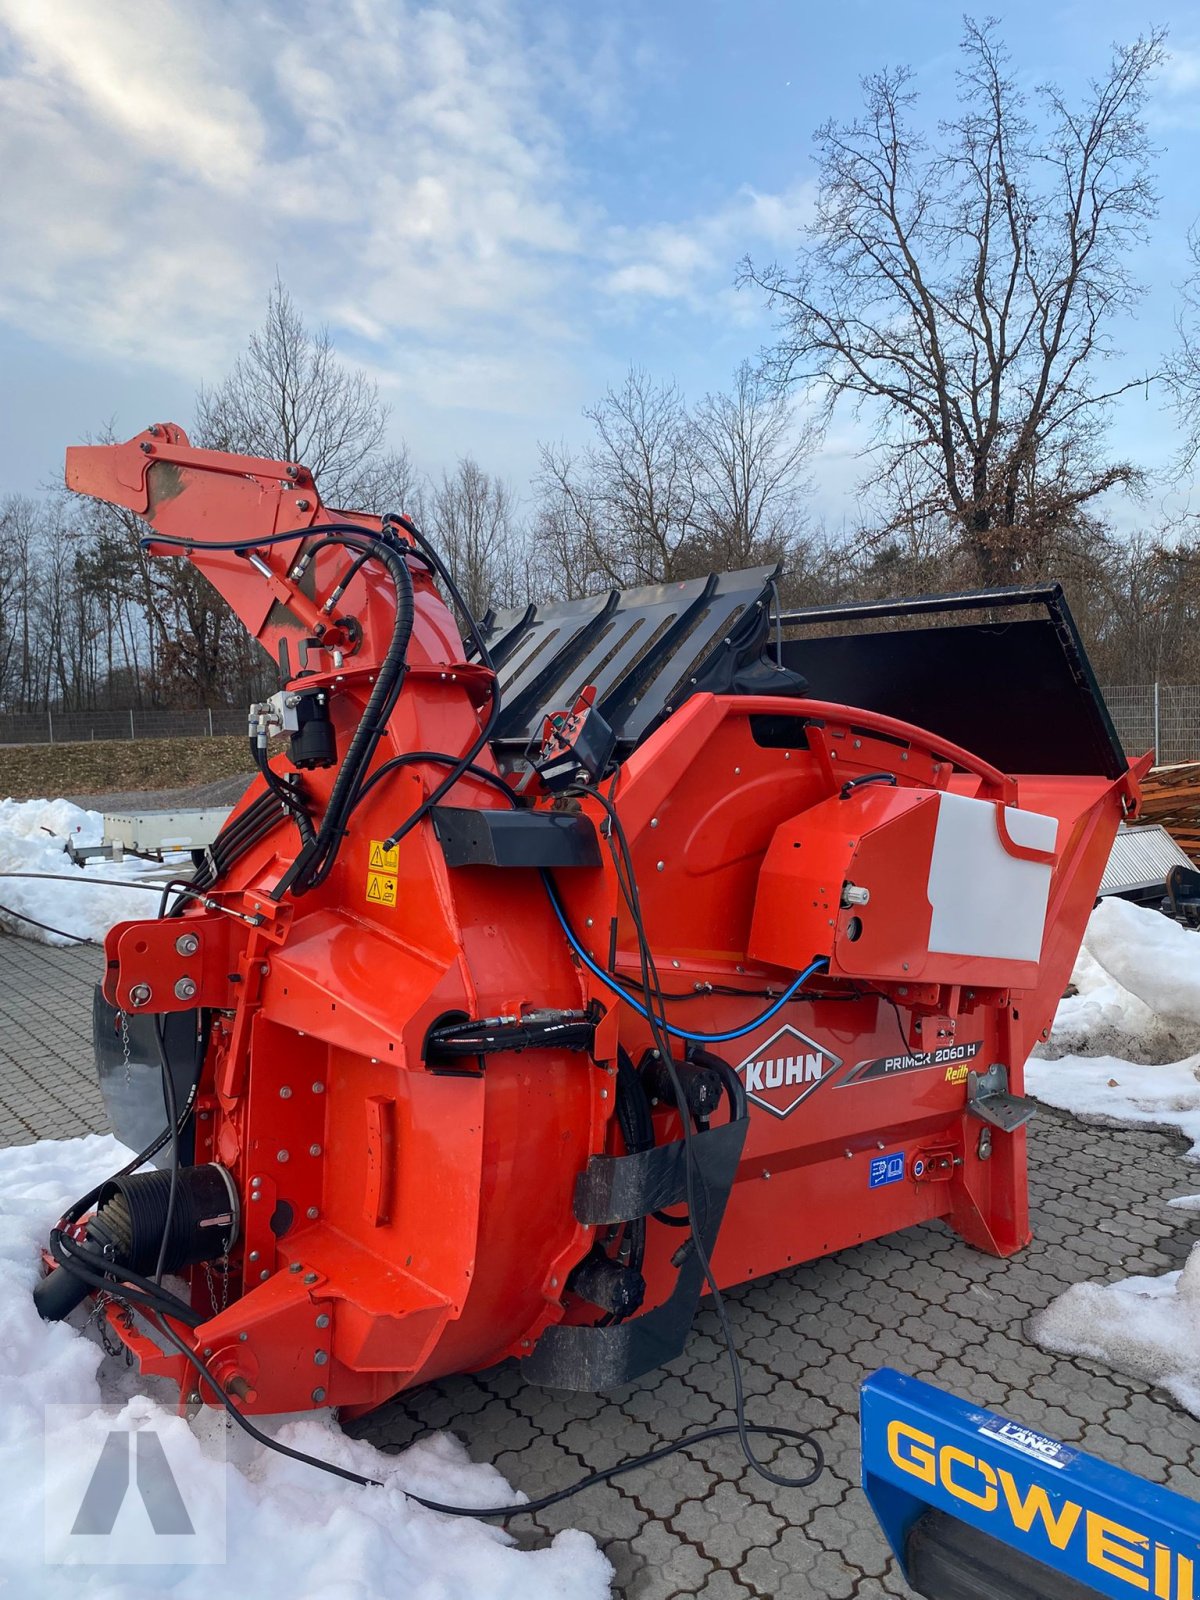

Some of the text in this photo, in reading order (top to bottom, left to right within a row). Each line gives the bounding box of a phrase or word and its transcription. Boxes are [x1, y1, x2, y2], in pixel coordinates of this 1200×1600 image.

[935, 1046, 964, 1062] 2060
[967, 1043, 976, 1057] H
[745, 1052, 823, 1092] KUHN
[998, 1425, 1059, 1457] LANG
[1006, 1421, 1064, 1450] Landtechnik
